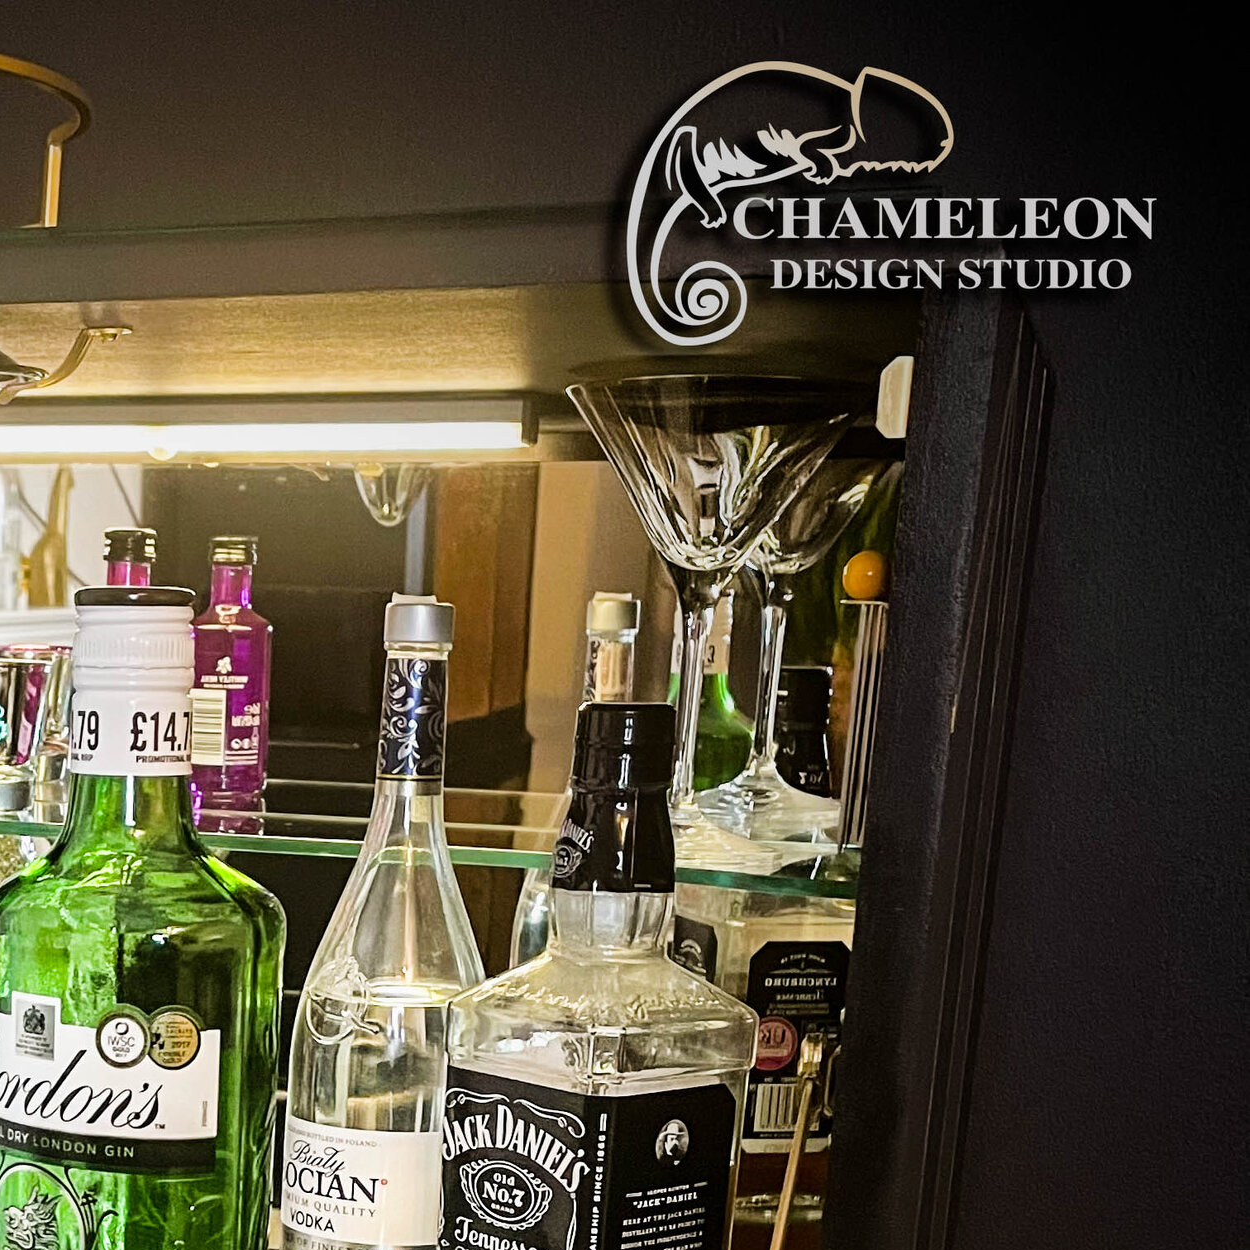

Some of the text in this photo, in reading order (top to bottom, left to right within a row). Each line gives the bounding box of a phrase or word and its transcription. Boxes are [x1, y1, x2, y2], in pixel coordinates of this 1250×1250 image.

[71, 710, 99, 751] .79
[108, 1036, 135, 1047] IWSC
[7, 1128, 29, 1144] DRY
[33, 1138, 96, 1155] LONDON
[104, 1145, 134, 1158] GIN
[345, 1139, 378, 1148] POLAND
[442, 1104, 591, 1193] JACK DANIEL'S
[493, 1172, 516, 1187] Old
[593, 1166, 603, 1202] SINCE
[666, 1192, 698, 1204] DANIEL
[290, 1207, 335, 1233] VODKA
[313, 1201, 376, 1218] QUALITY
